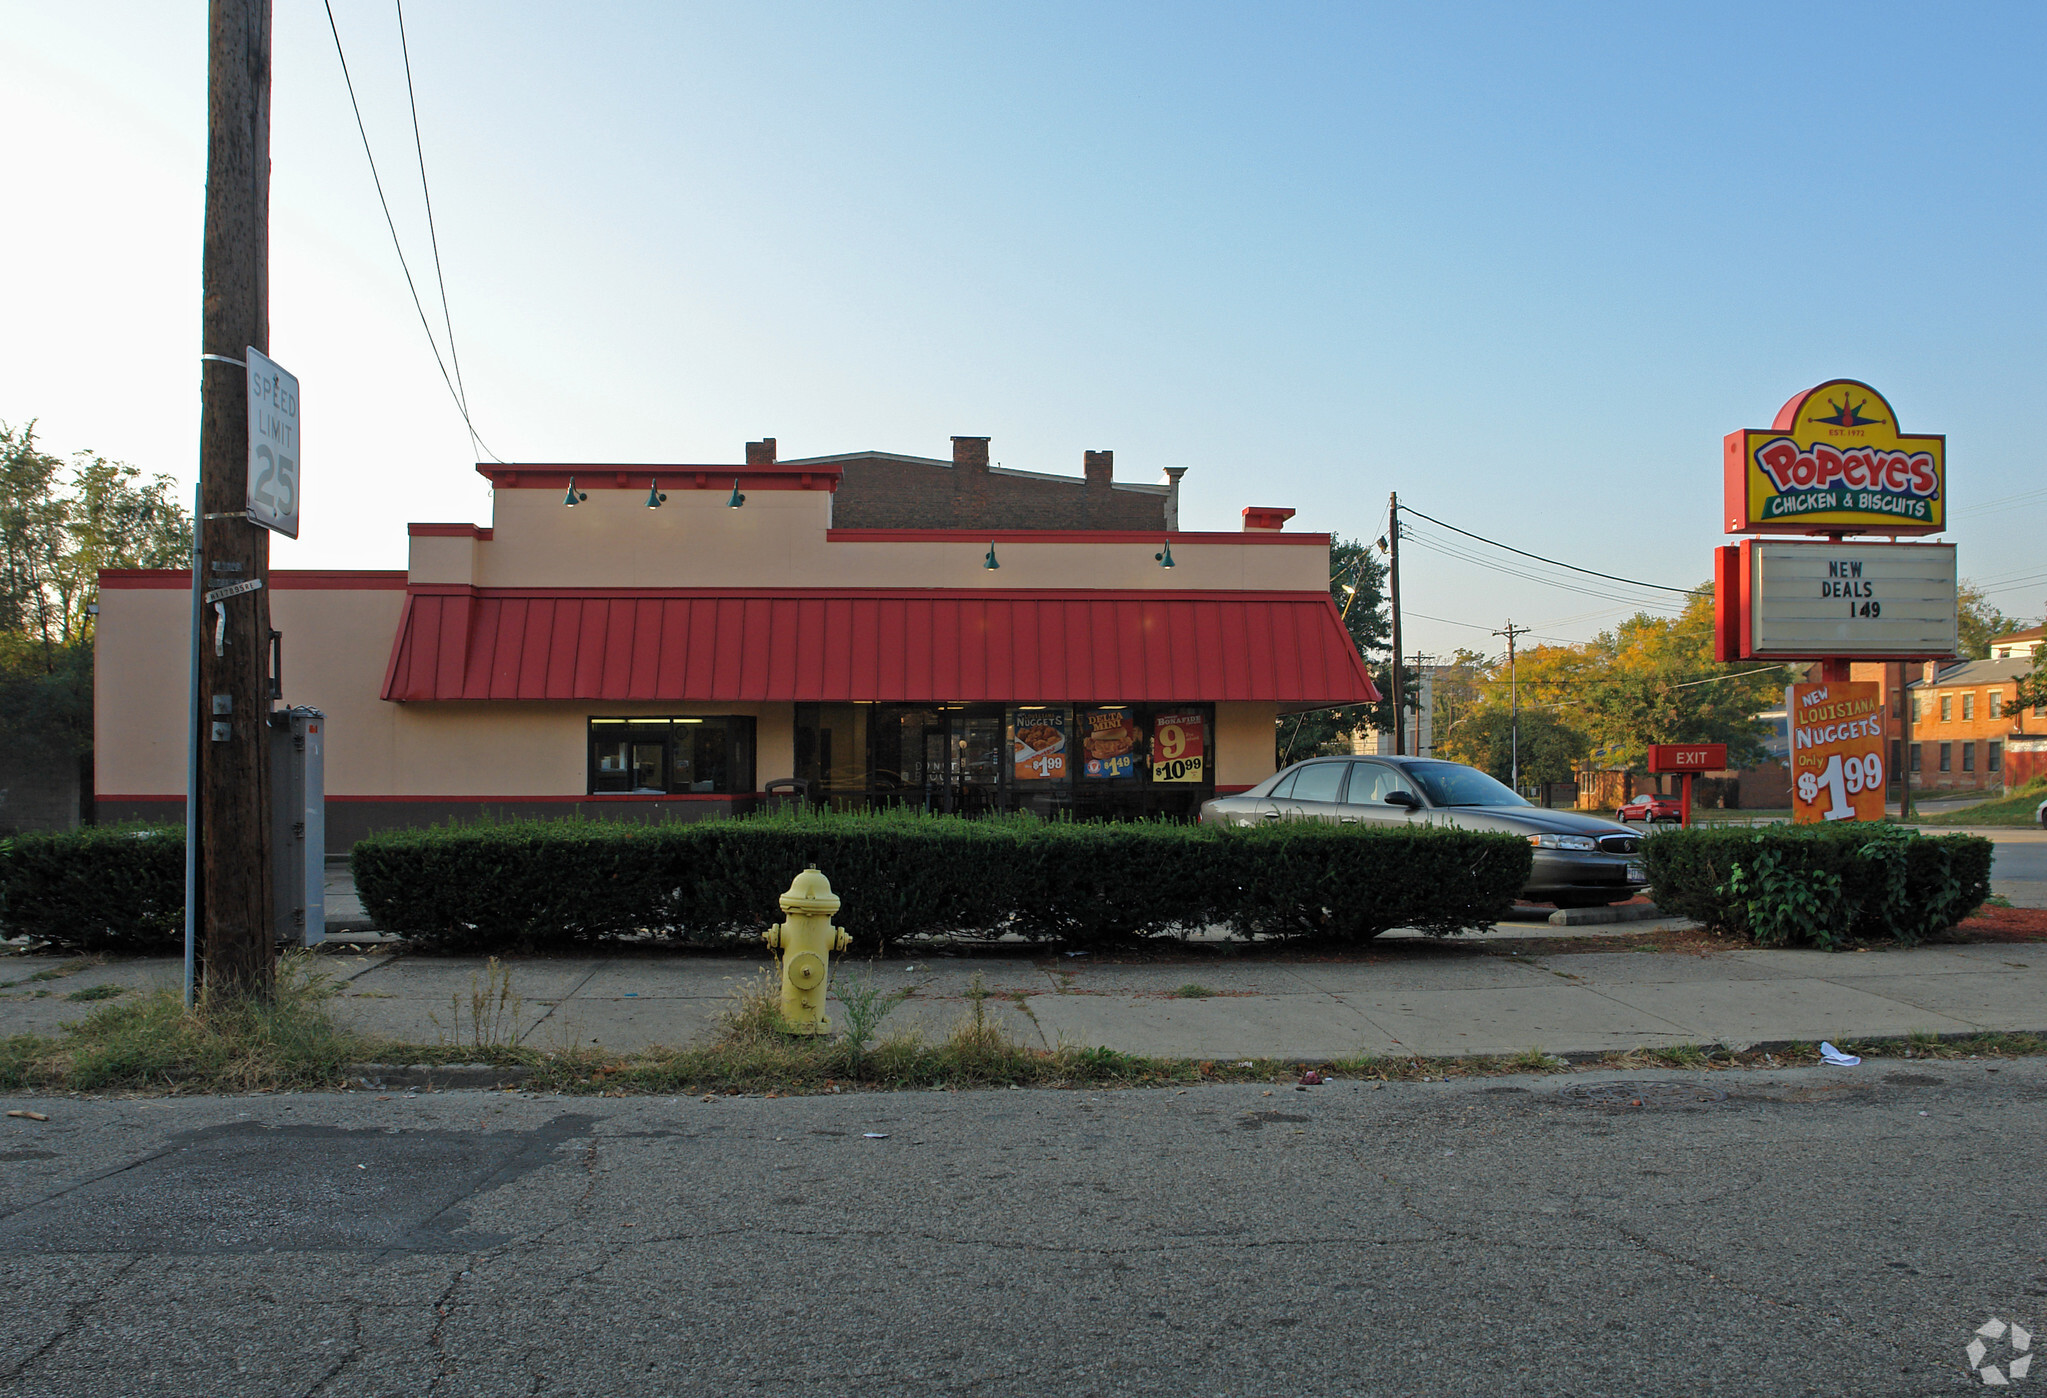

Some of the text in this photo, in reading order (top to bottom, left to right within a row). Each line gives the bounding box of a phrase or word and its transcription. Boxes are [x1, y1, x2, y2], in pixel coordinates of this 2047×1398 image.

[253, 373, 296, 418] SPEED
[259, 409, 292, 449] LIMIT
[1829, 429, 1865, 437] EST. 1972
[1760, 442, 1935, 494] POPEYES
[254, 443, 295, 516] 25
[1772, 492, 1926, 517] CHICKEN & BISCUITS
[1829, 561, 1863, 578] NEW
[1822, 581, 1873, 598] DEALS
[1801, 687, 1829, 707] NEW
[1088, 712, 1124, 725] DELTA
[1798, 698, 1876, 725] LOUISIANA
[1016, 716, 1063, 726] NUGGETS
[1093, 719, 1122, 732] MINI
[1156, 715, 1201, 727] BONAFIDE
[1795, 714, 1881, 750] NUGGETS
[1159, 724, 1186, 759] 9
[1676, 752, 1708, 765] EXIT
[1798, 754, 1824, 769] Only
